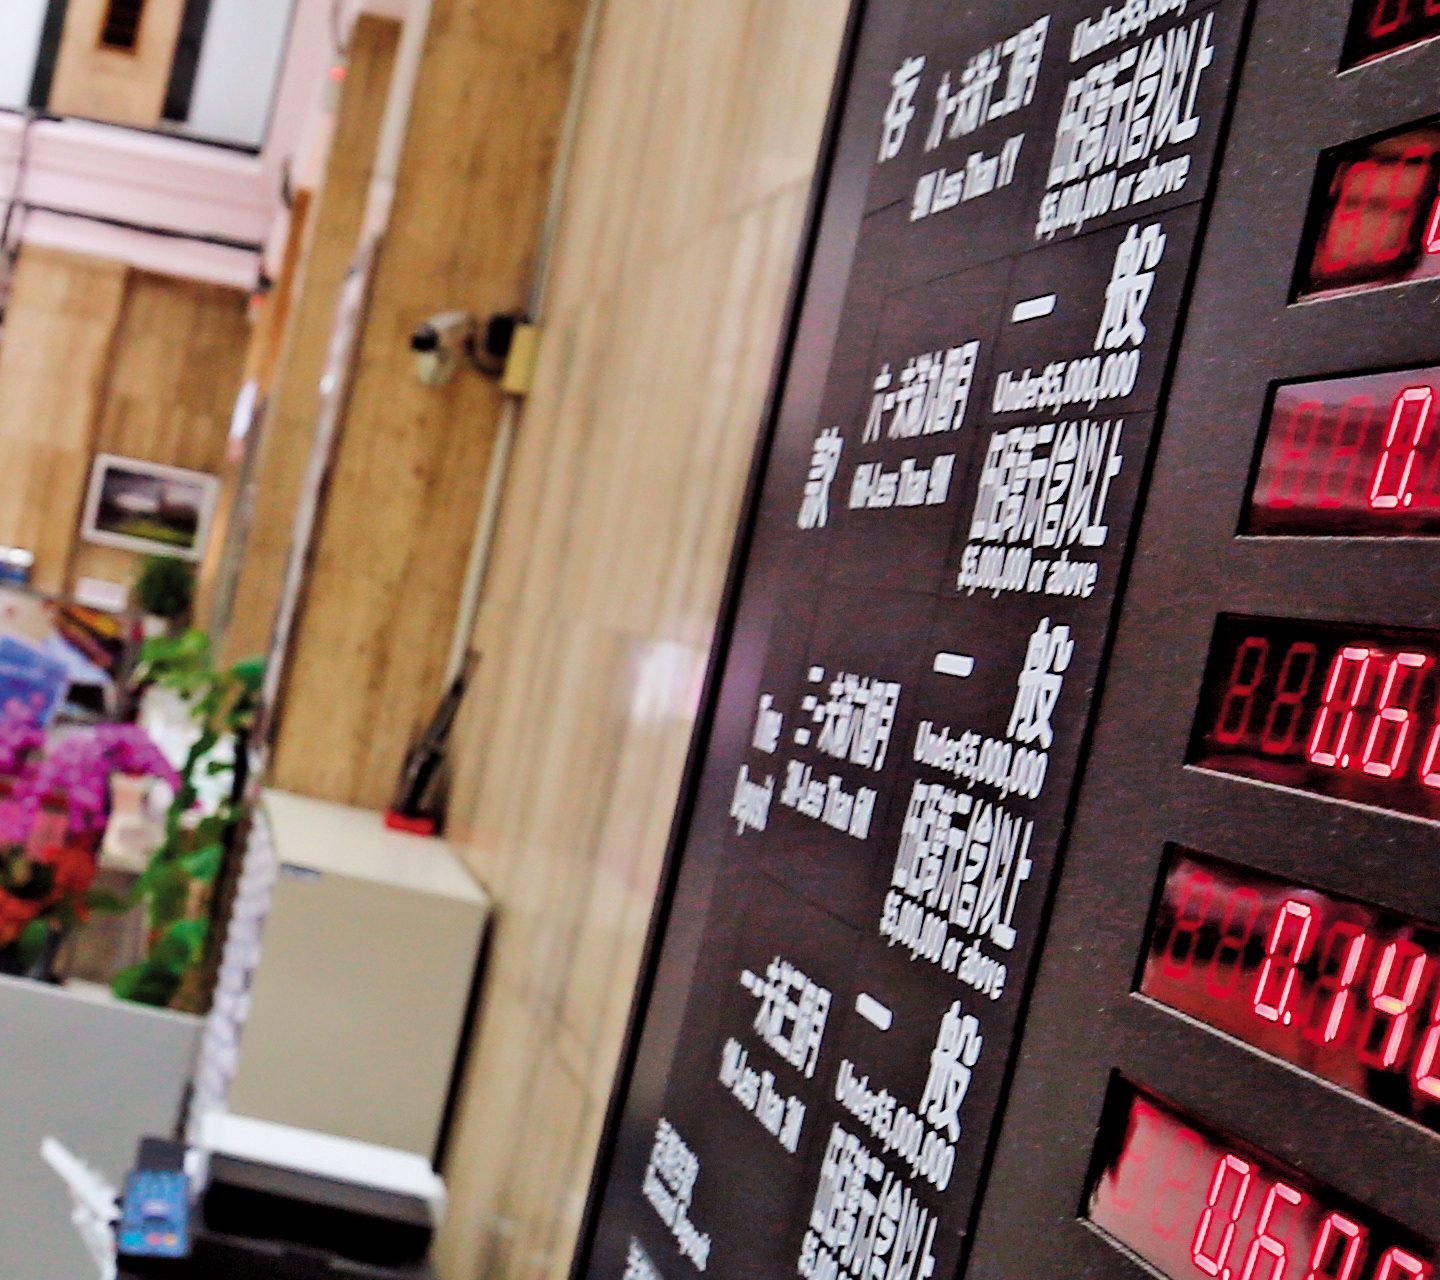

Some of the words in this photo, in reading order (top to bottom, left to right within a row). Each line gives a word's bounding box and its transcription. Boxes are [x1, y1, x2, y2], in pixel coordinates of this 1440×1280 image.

[1132, 154, 1191, 206] above
[1026, 560, 1047, 594] or
[1044, 550, 1099, 599] above
[959, 938, 1008, 1000] above
